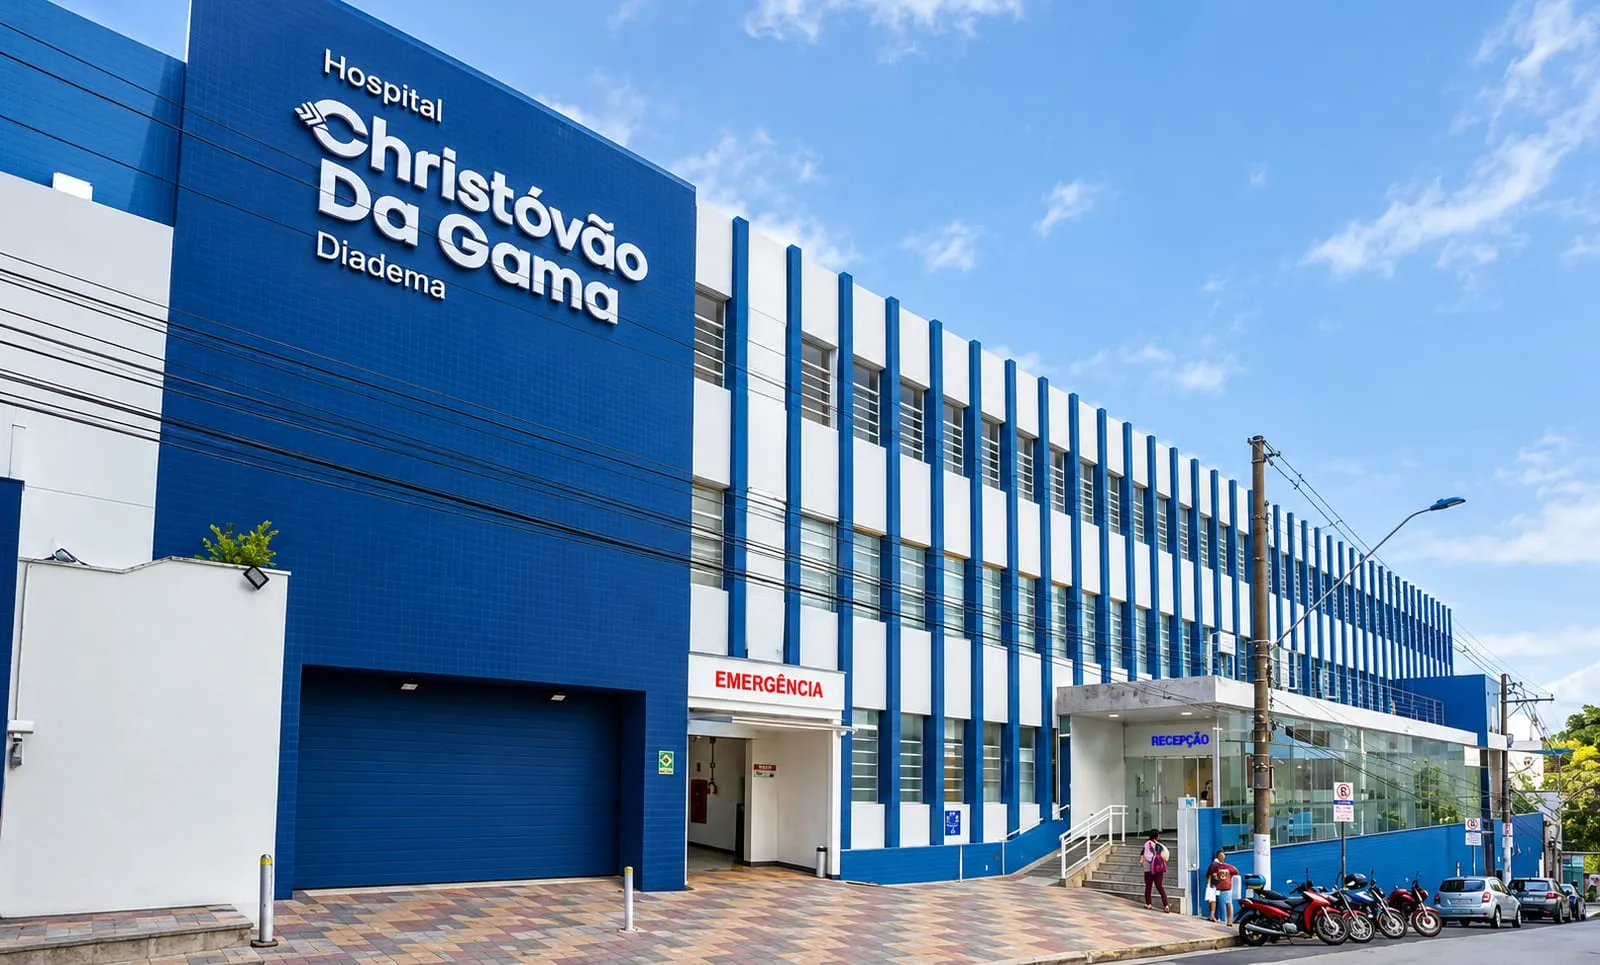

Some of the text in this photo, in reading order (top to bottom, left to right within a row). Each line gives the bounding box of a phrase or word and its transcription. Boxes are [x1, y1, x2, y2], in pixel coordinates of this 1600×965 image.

[324, 48, 442, 123] Hospital
[294, 99, 649, 282] Christóvão
[317, 230, 446, 299] Diadema
[318, 157, 618, 325] Da Gama
[715, 670, 823, 698] EMERGÊNCIA
[1151, 731, 1210, 748] RECEPÇÃO
